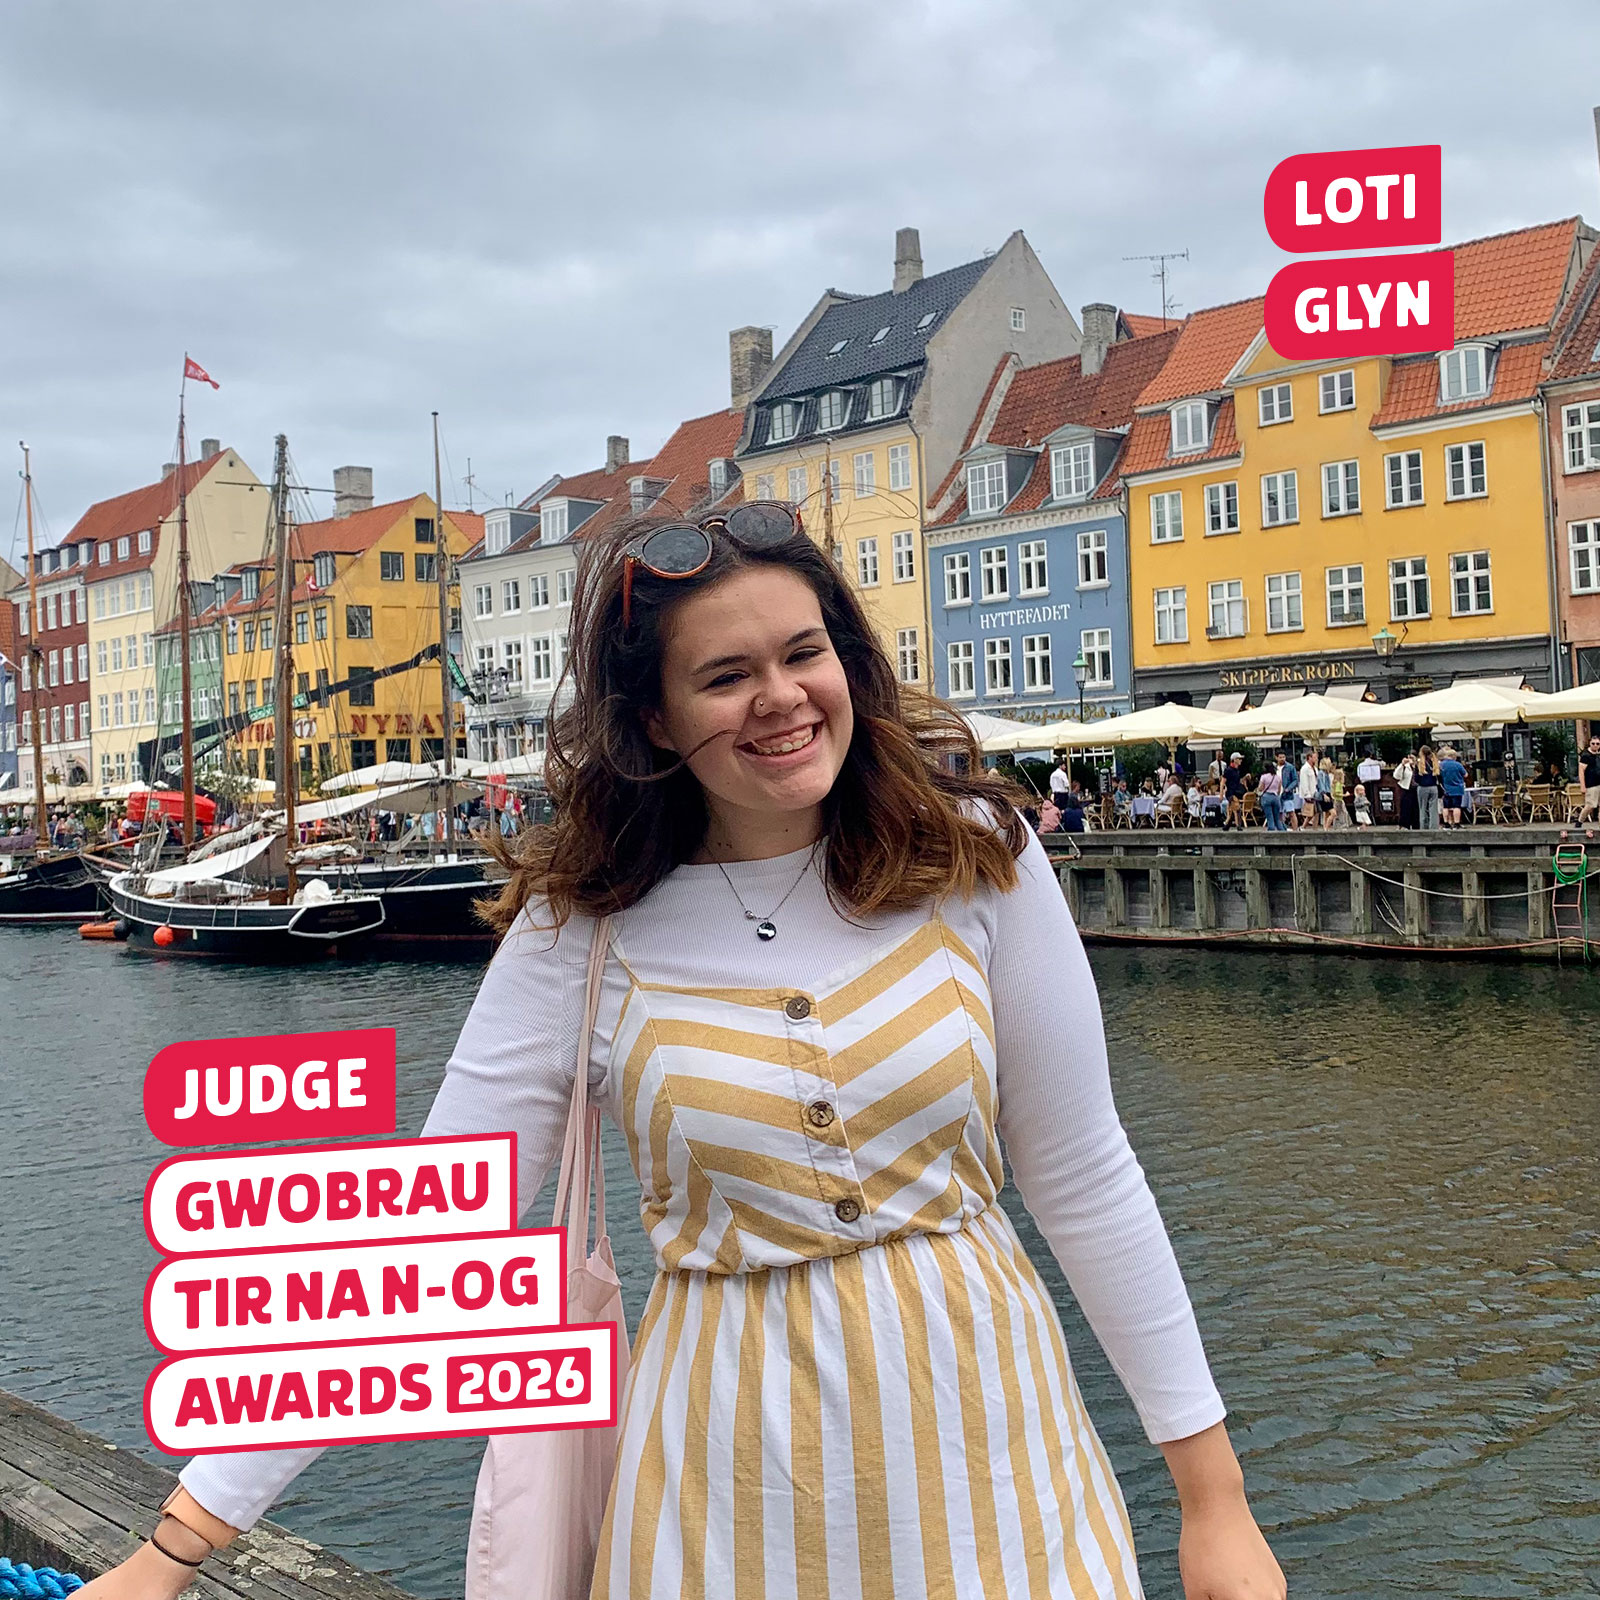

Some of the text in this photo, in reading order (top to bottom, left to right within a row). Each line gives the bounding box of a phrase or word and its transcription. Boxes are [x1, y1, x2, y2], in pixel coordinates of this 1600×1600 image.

[980, 604, 1071, 629] HYTTEFADET
[1220, 662, 1356, 687] SKIPPERKROEN
[296, 717, 317, 739] 17
